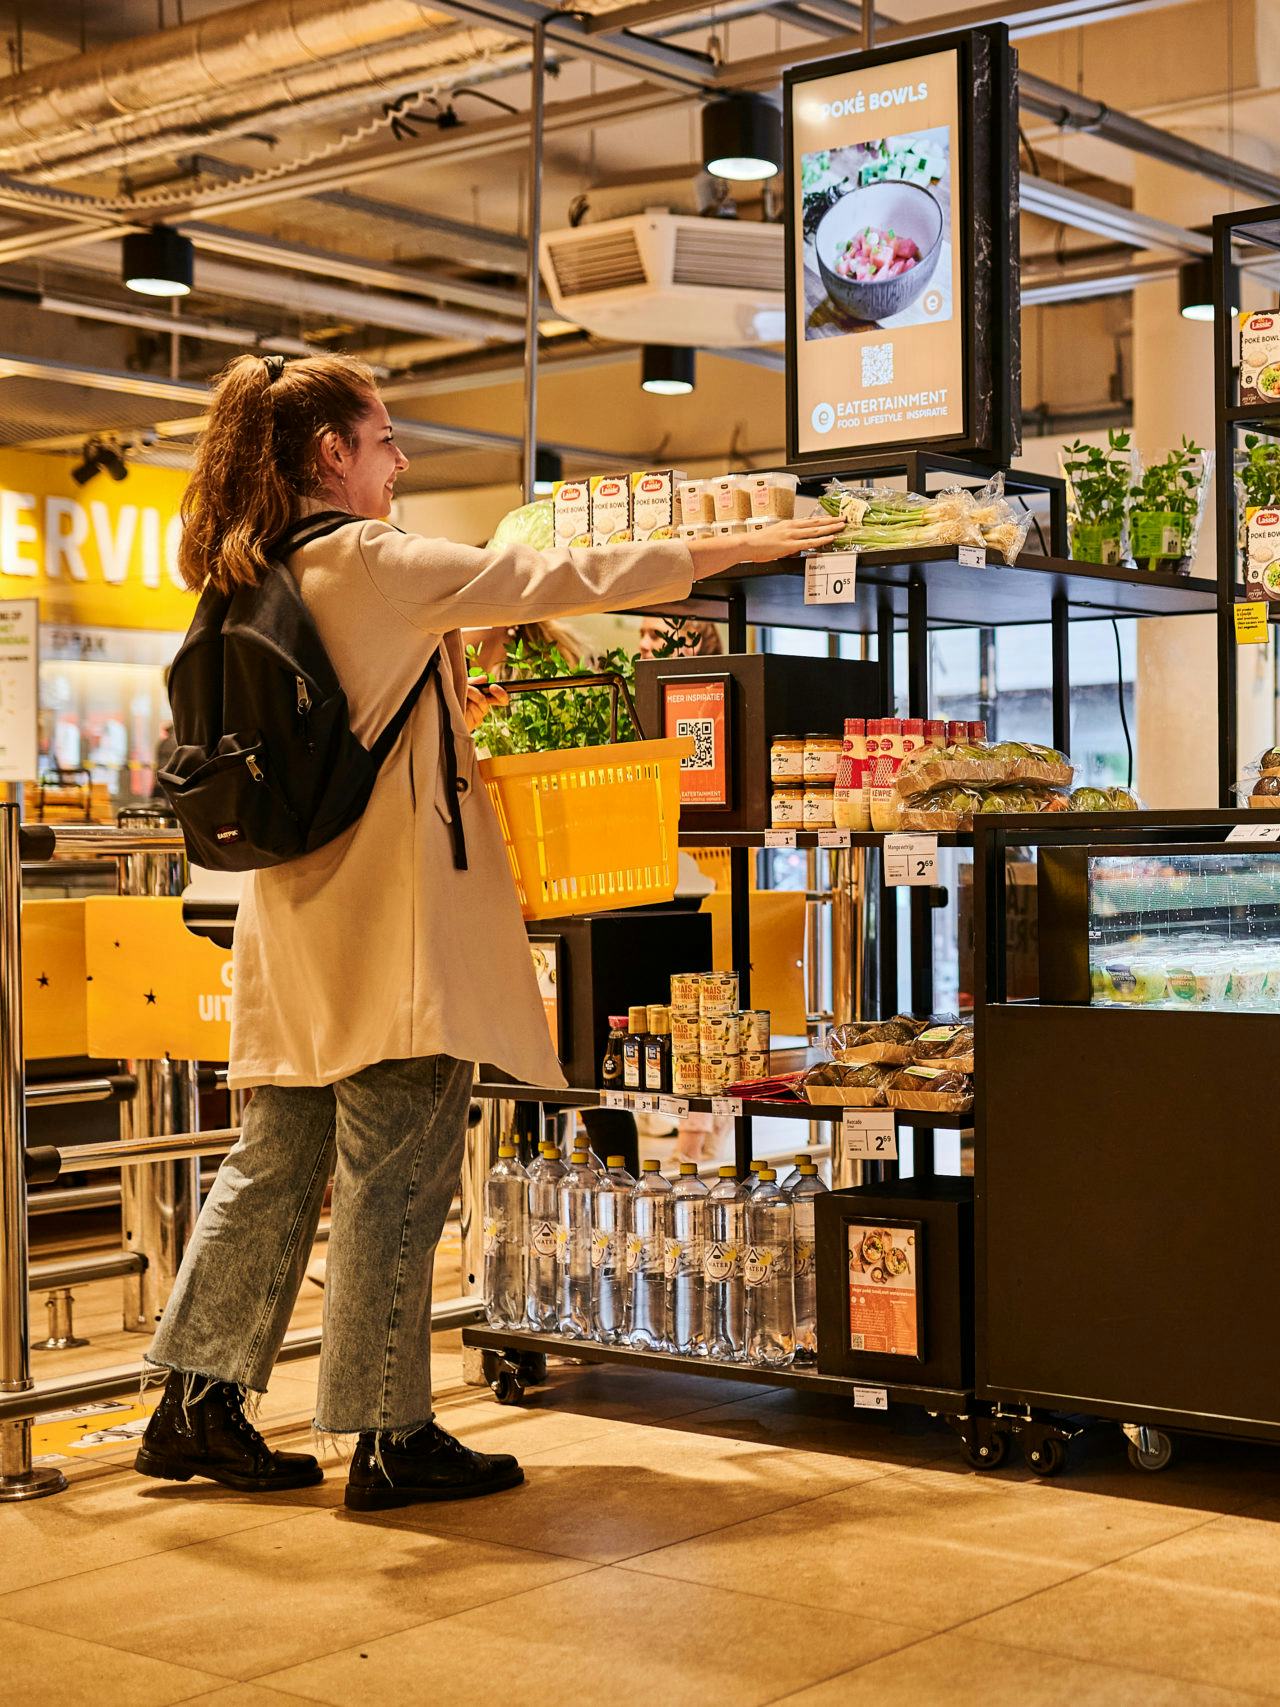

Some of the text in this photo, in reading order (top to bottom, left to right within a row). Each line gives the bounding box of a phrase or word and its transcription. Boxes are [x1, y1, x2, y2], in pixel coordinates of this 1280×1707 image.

[822, 83, 928, 120] POKÉ BOWLS
[837, 389, 948, 417] EATERTAINMENT
[837, 406, 948, 429] FOOD LIFESTYLE INSPIRATIE
[667, 693, 725, 703] MEER INSPIRATIE?
[872, 789, 892, 798] KEWPIE
